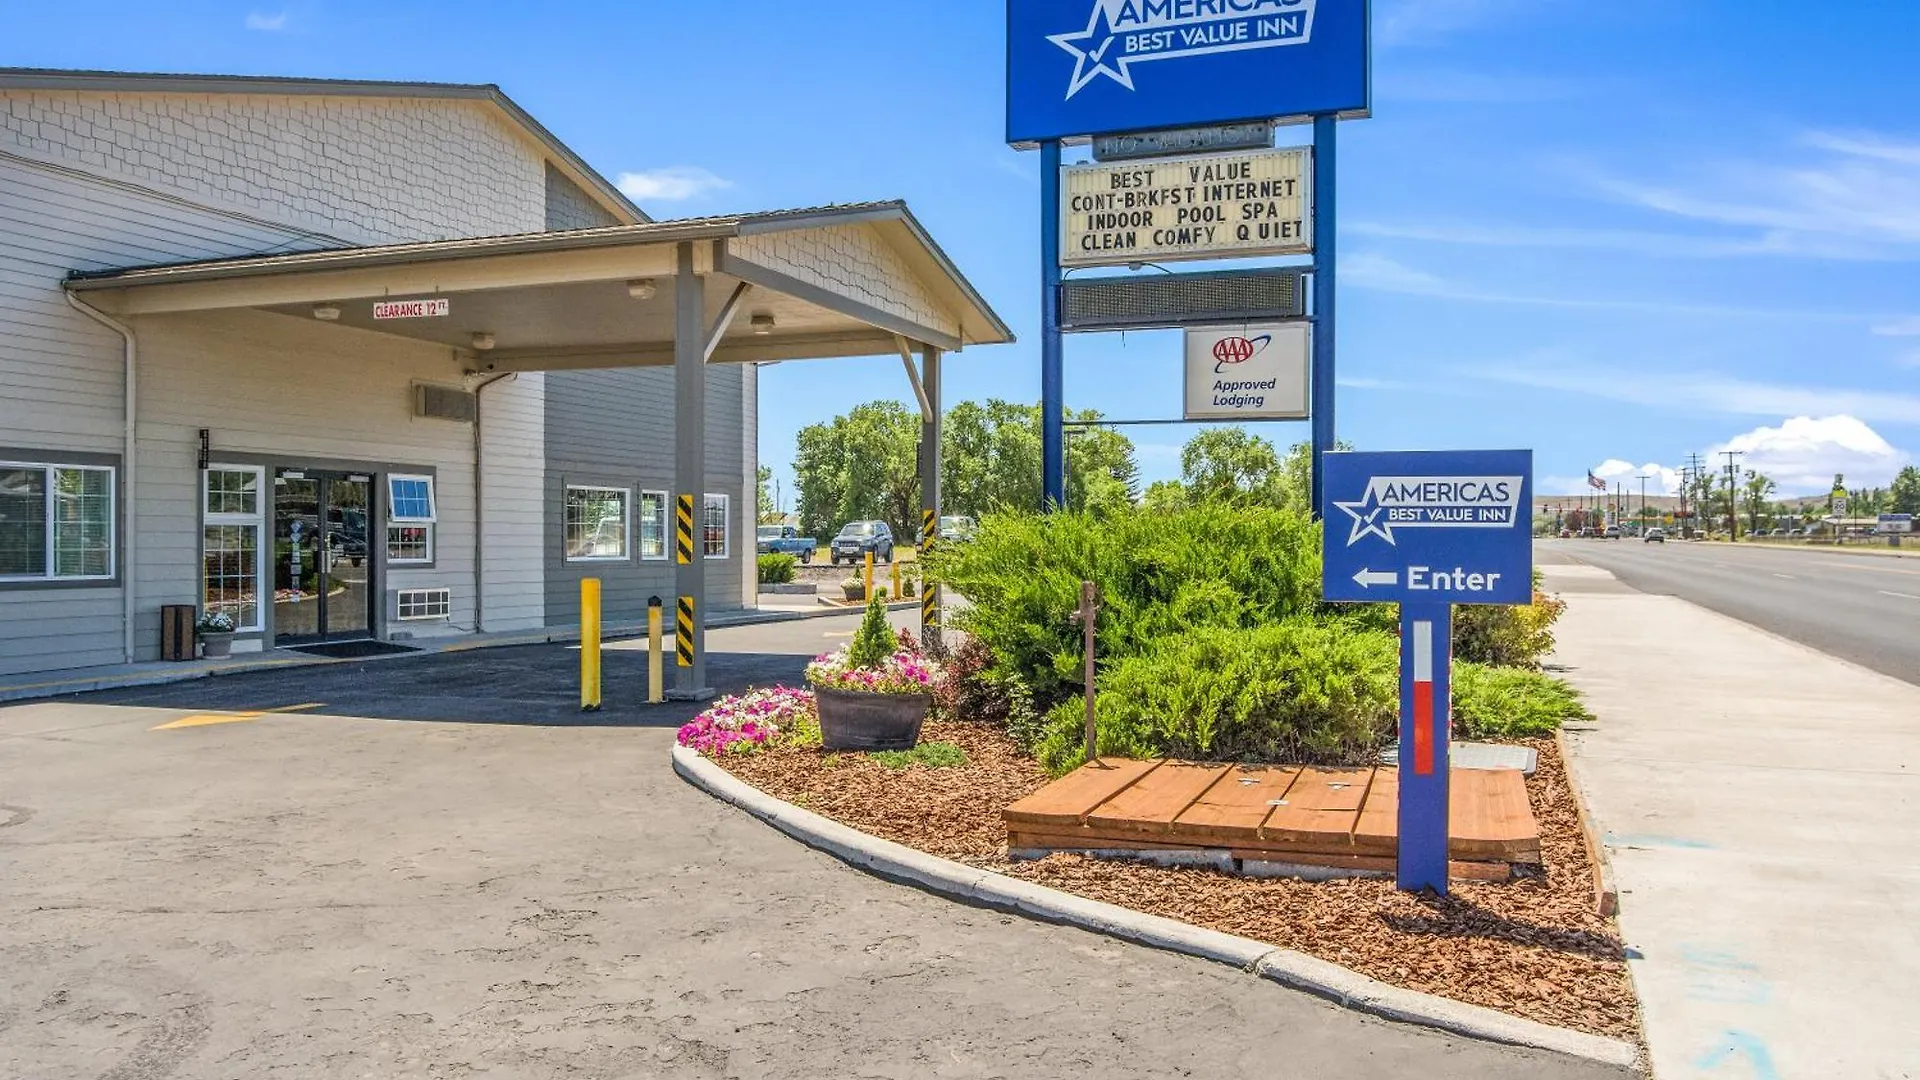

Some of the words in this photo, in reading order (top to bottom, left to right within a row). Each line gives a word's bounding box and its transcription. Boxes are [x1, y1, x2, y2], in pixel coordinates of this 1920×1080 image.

[1114, 0, 1300, 27] AMERI
[1125, 31, 1175, 53] BEST
[1180, 22, 1249, 46] VALUE
[1257, 16, 1298, 38] INN
[1105, 136, 1137, 155] NO
[1110, 170, 1155, 189] BEST
[1189, 162, 1251, 183] VALUE
[1071, 186, 1195, 212] CONT-BRKFST
[1203, 179, 1296, 202] INTERNET
[1088, 211, 1153, 230] INDOOR
[1177, 205, 1226, 224] POOL
[1242, 203, 1278, 220] SPA
[1081, 231, 1136, 250] CLEAN
[1153, 226, 1217, 246] COMFY
[375, 303, 422, 318] CLEARANCE
[426, 303, 437, 315] 12
[1217, 337, 1250, 363] AAA
[1213, 378, 1276, 393] Approved
[1213, 394, 1264, 408] Lodging
[1381, 482, 1510, 502] AMERICAS
[1389, 508, 1424, 521] BEST
[1427, 508, 1473, 521] VALUE
[1479, 508, 1506, 521] INN
[1407, 566, 1501, 591] Enter
